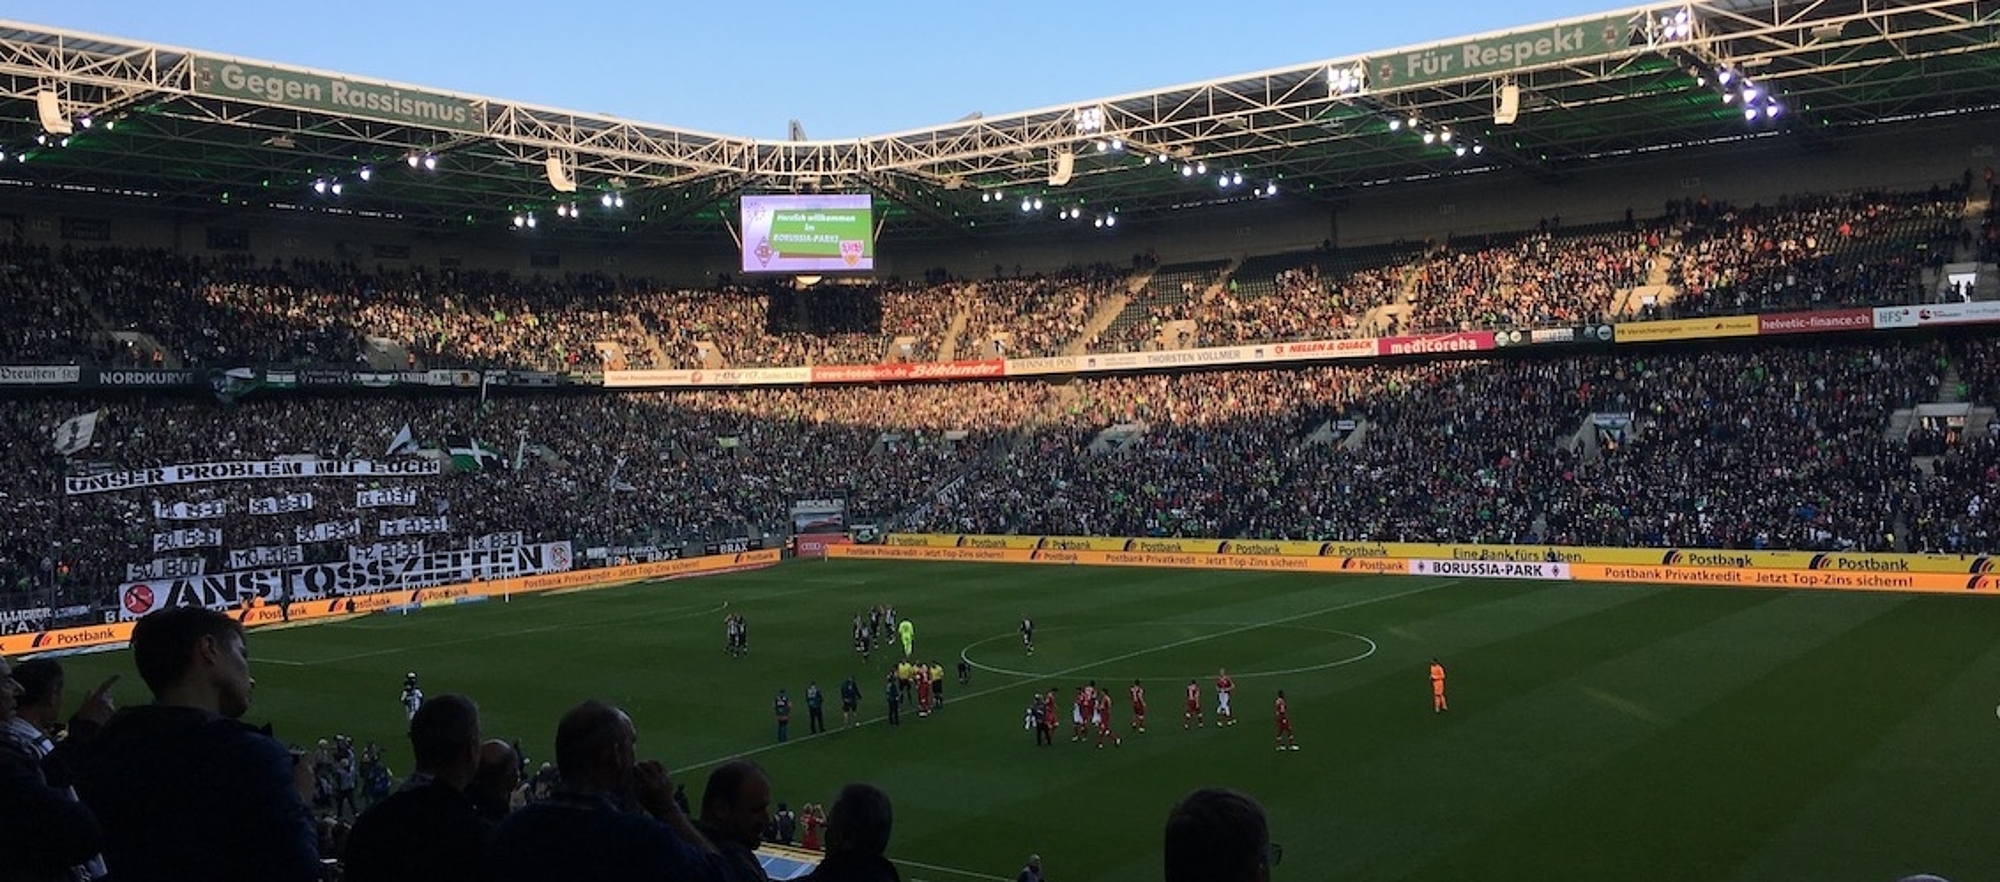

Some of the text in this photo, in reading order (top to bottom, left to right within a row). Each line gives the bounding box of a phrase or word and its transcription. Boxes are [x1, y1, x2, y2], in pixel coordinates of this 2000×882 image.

[1407, 27, 1585, 78] Für Respekt
[221, 64, 466, 125] Gegen Rassismus
[1762, 314, 1870, 331] helvetic-finance.ch
[1391, 338, 1478, 354] medicoreha
[1147, 354, 1195, 365] THORSTEN
[100, 371, 194, 385] NORDKURVE
[69, 469, 165, 492] UNSER
[178, 461, 302, 481] PROBLEM
[719, 544, 747, 555] BRAX
[971, 538, 1007, 551] Postbank
[1141, 543, 1182, 554] Postbank
[1237, 544, 1281, 557] Postbank
[1340, 545, 1387, 559] Postbank
[235, 550, 263, 566] MO.
[746, 553, 774, 562] Postbank
[846, 547, 875, 557] Postbank
[877, 548, 918, 558] Privatkredit
[924, 549, 940, 559] Jetzt
[942, 550, 974, 561] Top-Zins
[976, 552, 1004, 561] sichern!
[1043, 553, 1078, 563] Postbank
[1106, 553, 1144, 565] Postbank
[1146, 555, 1196, 567] Privatkredit
[1206, 557, 1226, 569] Jetzt
[1228, 557, 1265, 571] Top-Zins
[1266, 559, 1308, 571] sichern!
[1453, 549, 1585, 564] Eine Bank fürs Lben.
[1360, 560, 1404, 574] Postbank
[1432, 561, 1543, 578] BORUSSIA-PARK
[1839, 557, 1910, 572] Postbank
[164, 546, 543, 611] ANSTOSSZEITEN
[524, 576, 562, 589] Postbank
[564, 570, 611, 584] Privatkredit
[619, 566, 637, 578] Jetzt
[639, 563, 671, 577] Top-Zins
[1605, 567, 1662, 582] Postbank
[1665, 568, 1741, 585] Privatkredit
[1755, 572, 1788, 586] Jetzt
[1793, 573, 1852, 589] Top-Zins
[1857, 574, 1913, 591] sichern!
[347, 597, 392, 613] ostbank
[259, 606, 307, 622] Postank
[57, 627, 115, 646] Postbank
